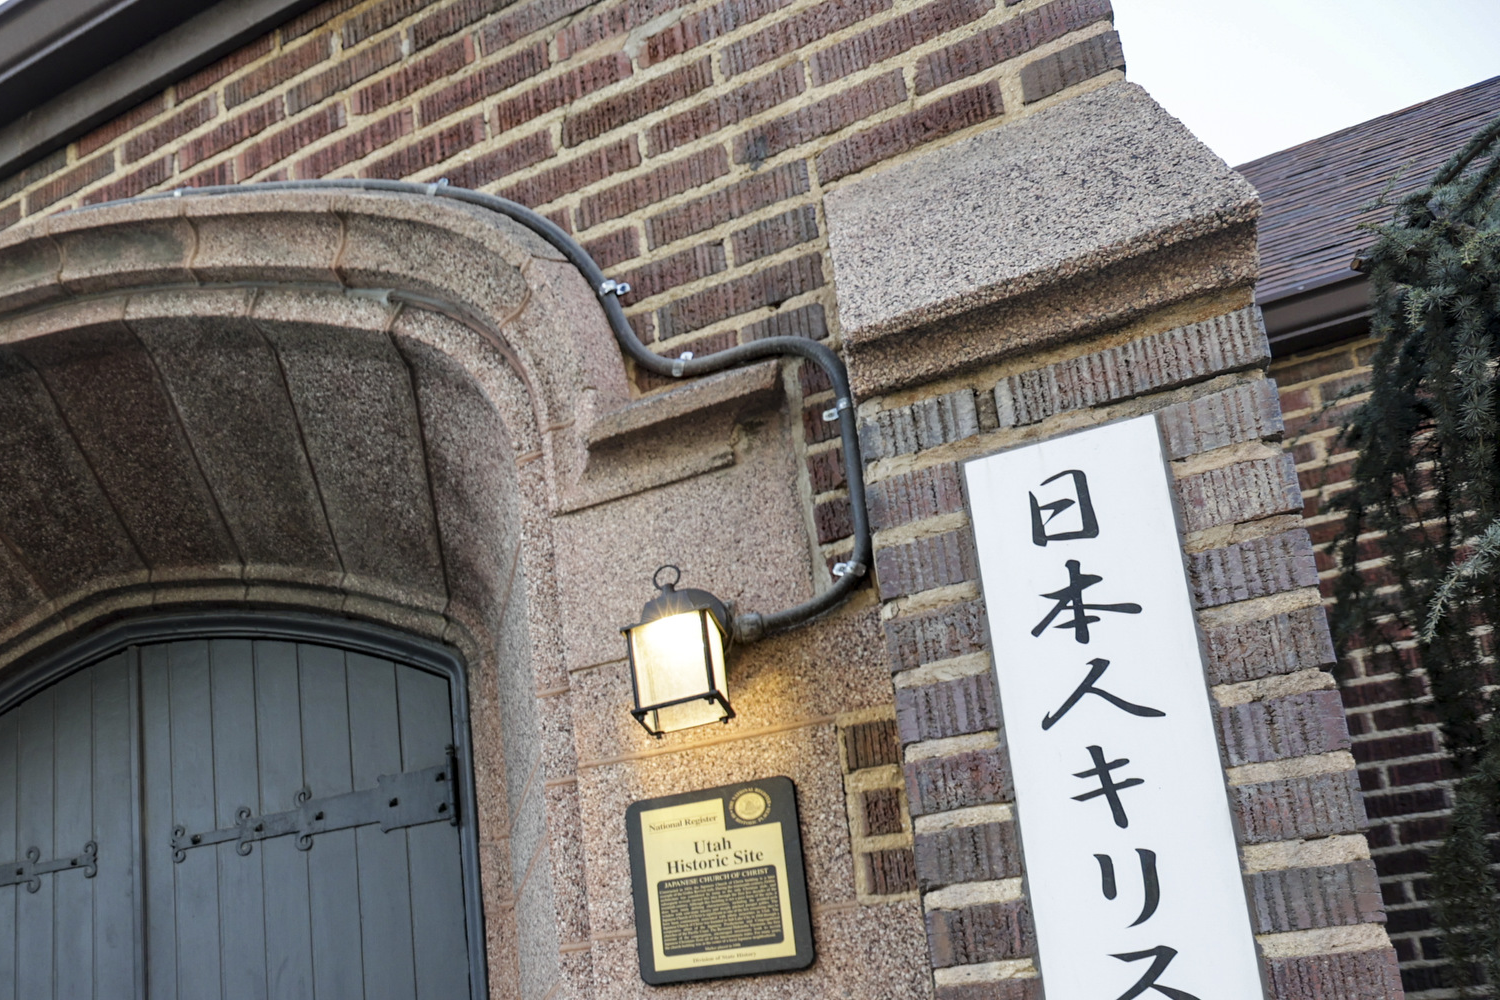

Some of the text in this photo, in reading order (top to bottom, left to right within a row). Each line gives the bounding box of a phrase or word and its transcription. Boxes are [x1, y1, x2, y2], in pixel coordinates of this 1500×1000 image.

[648, 819, 683, 832] National
[684, 815, 718, 828] Register
[693, 837, 732, 855] Utah
[666, 850, 764, 875] Historic Site
[664, 867, 769, 889] JAPANESE CHURCH OF CHRIST
